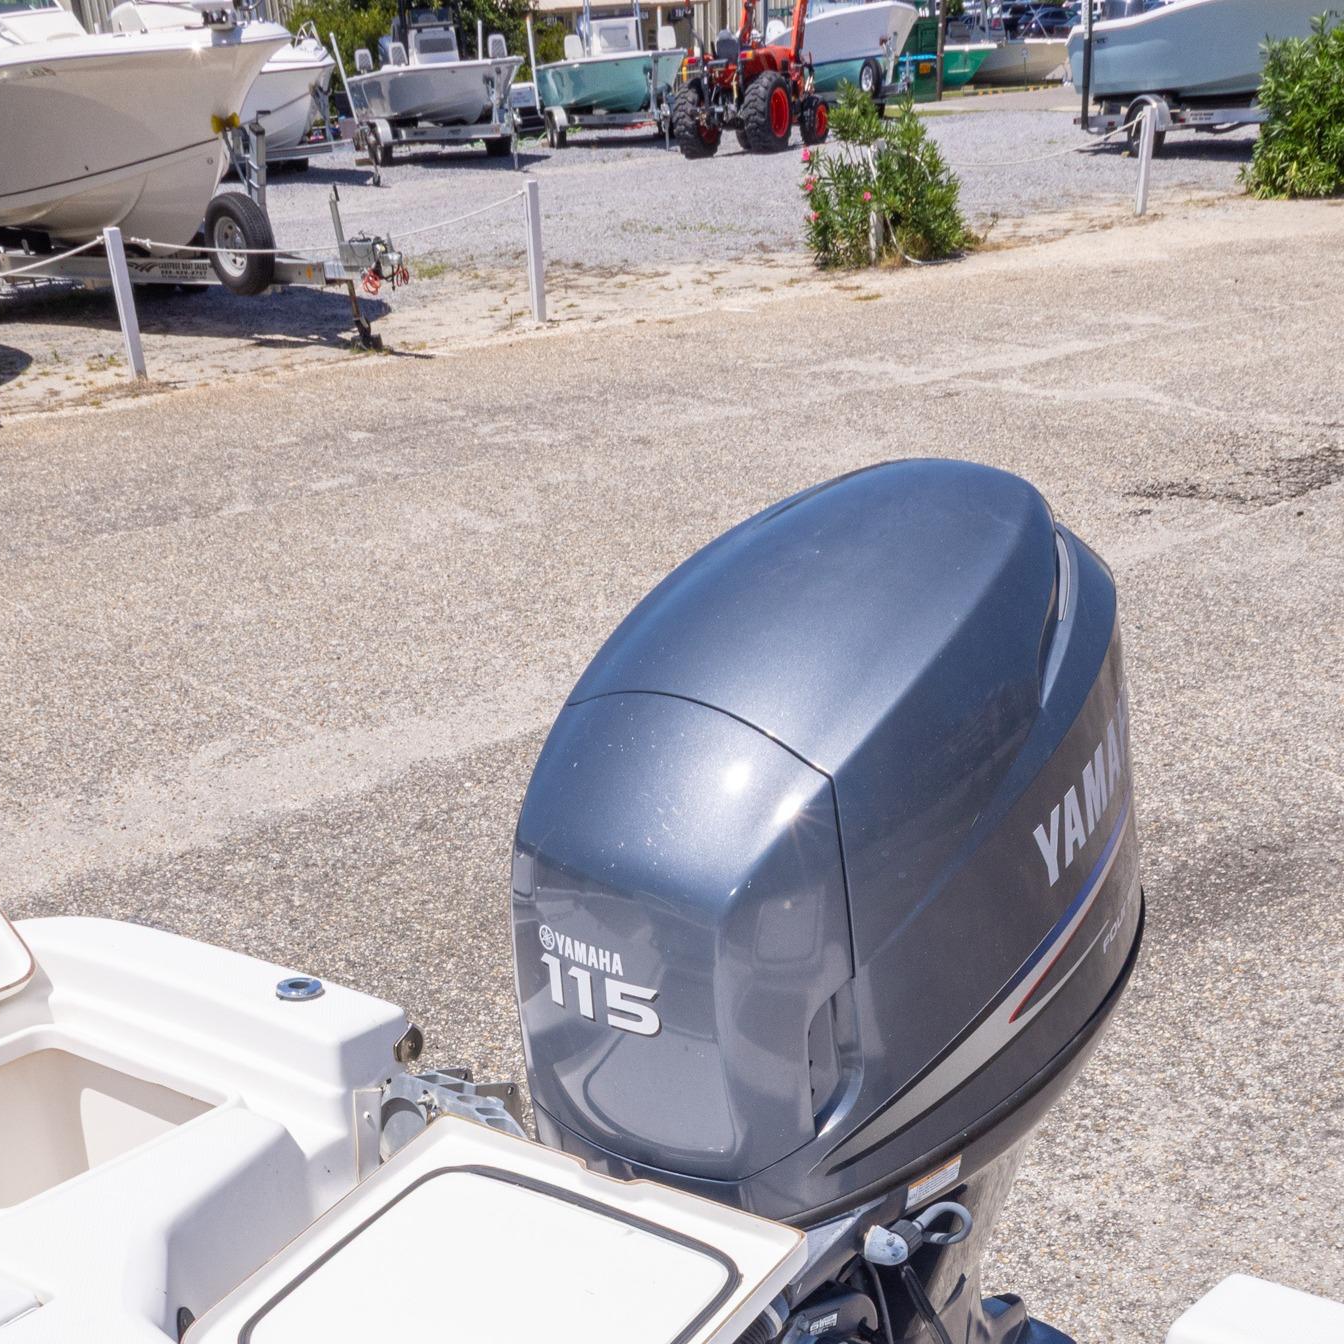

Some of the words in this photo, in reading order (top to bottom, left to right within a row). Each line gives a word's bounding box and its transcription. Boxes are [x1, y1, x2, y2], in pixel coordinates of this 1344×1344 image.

[1033, 683, 1129, 888] YAMAH
[540, 952, 662, 1037] 115
[555, 931, 624, 977] YAMAHA
